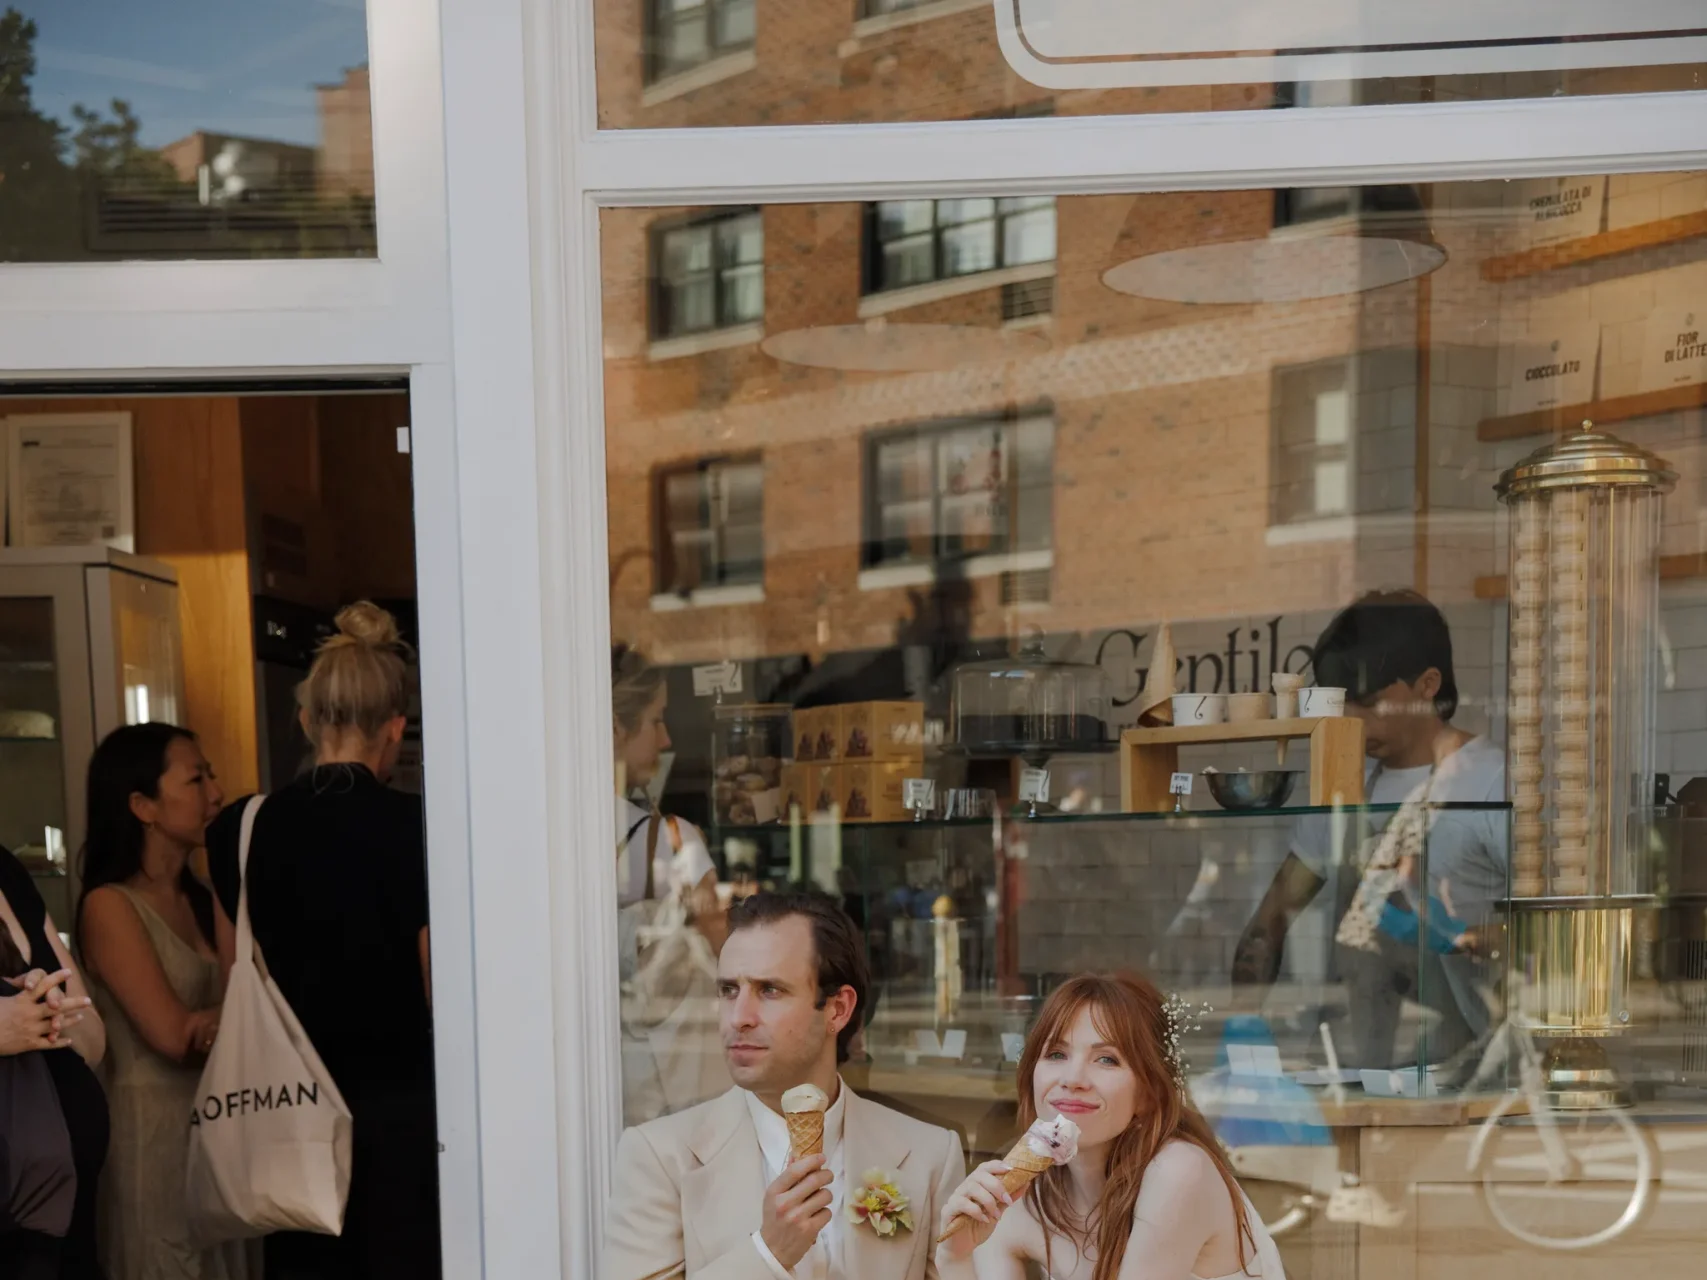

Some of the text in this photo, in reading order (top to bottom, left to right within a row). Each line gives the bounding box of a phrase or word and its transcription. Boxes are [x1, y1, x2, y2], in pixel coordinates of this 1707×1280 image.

[1676, 331, 1699, 347] FIOR
[1664, 343, 1707, 363] DI LATTE
